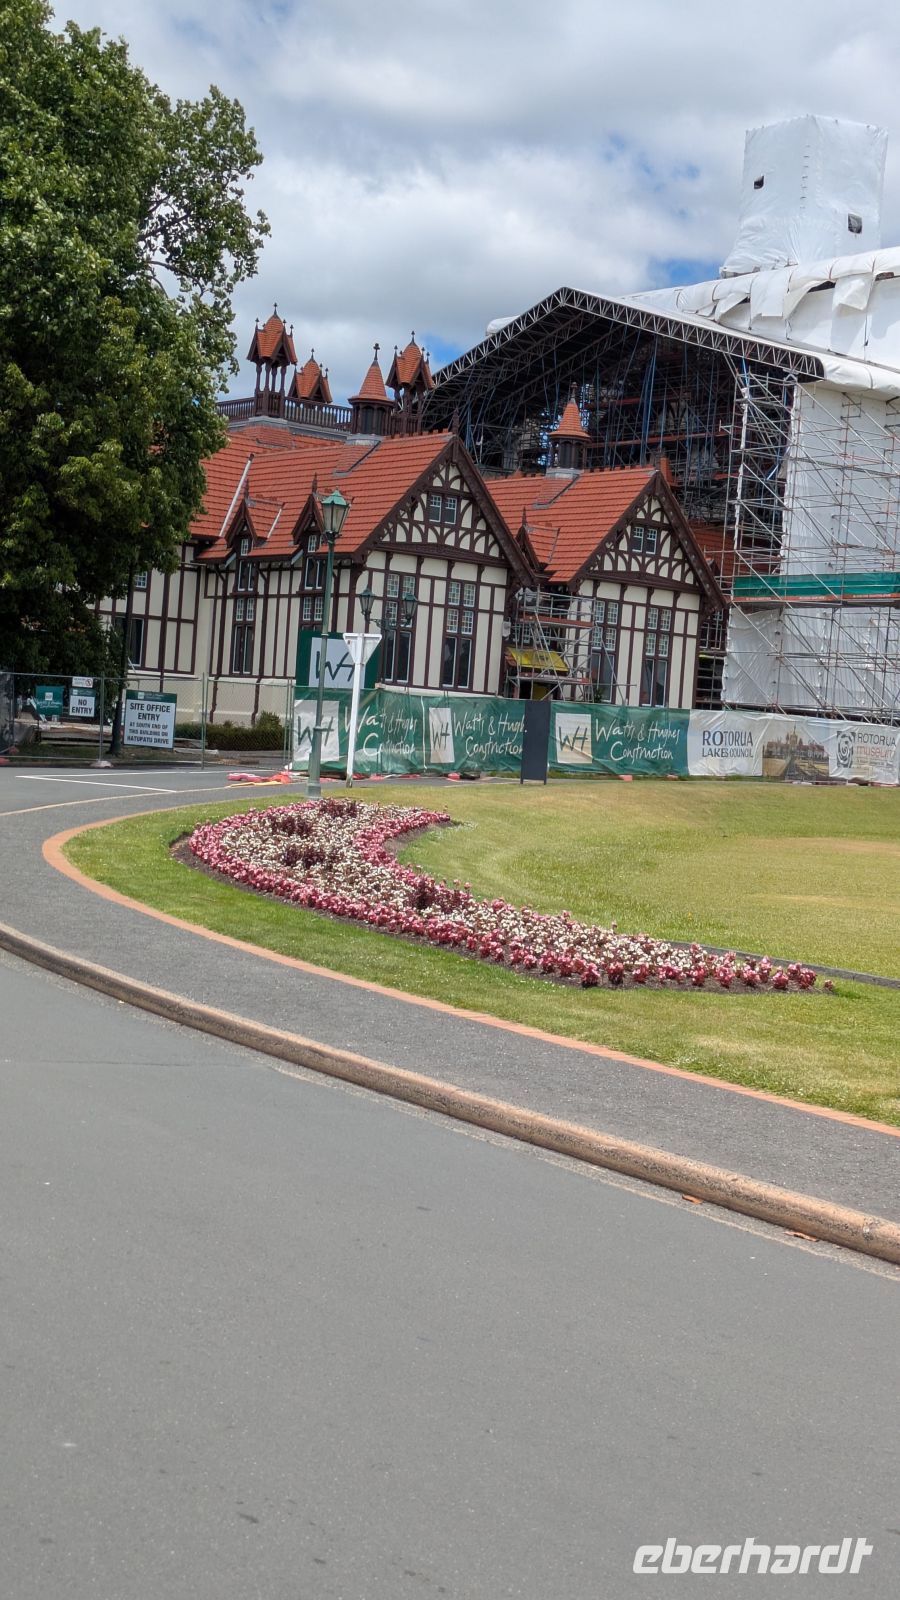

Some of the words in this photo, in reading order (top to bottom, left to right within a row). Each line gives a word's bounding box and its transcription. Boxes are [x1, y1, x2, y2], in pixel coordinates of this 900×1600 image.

[71, 706, 93, 714] ENTRY
[146, 704, 171, 712] OFFICE
[138, 713, 160, 721] ENTRY
[453, 712, 485, 737] Watts
[488, 716, 496, 735] &
[432, 722, 450, 750] WH
[558, 726, 588, 751] WH
[595, 718, 635, 743] Watts
[637, 724, 645, 741] &
[647, 720, 680, 747] Hughes
[702, 730, 753, 746] ROTORUA
[857, 732, 897, 747] ROTORUA
[610, 741, 674, 765] Construction
[702, 748, 728, 757] LAKES
